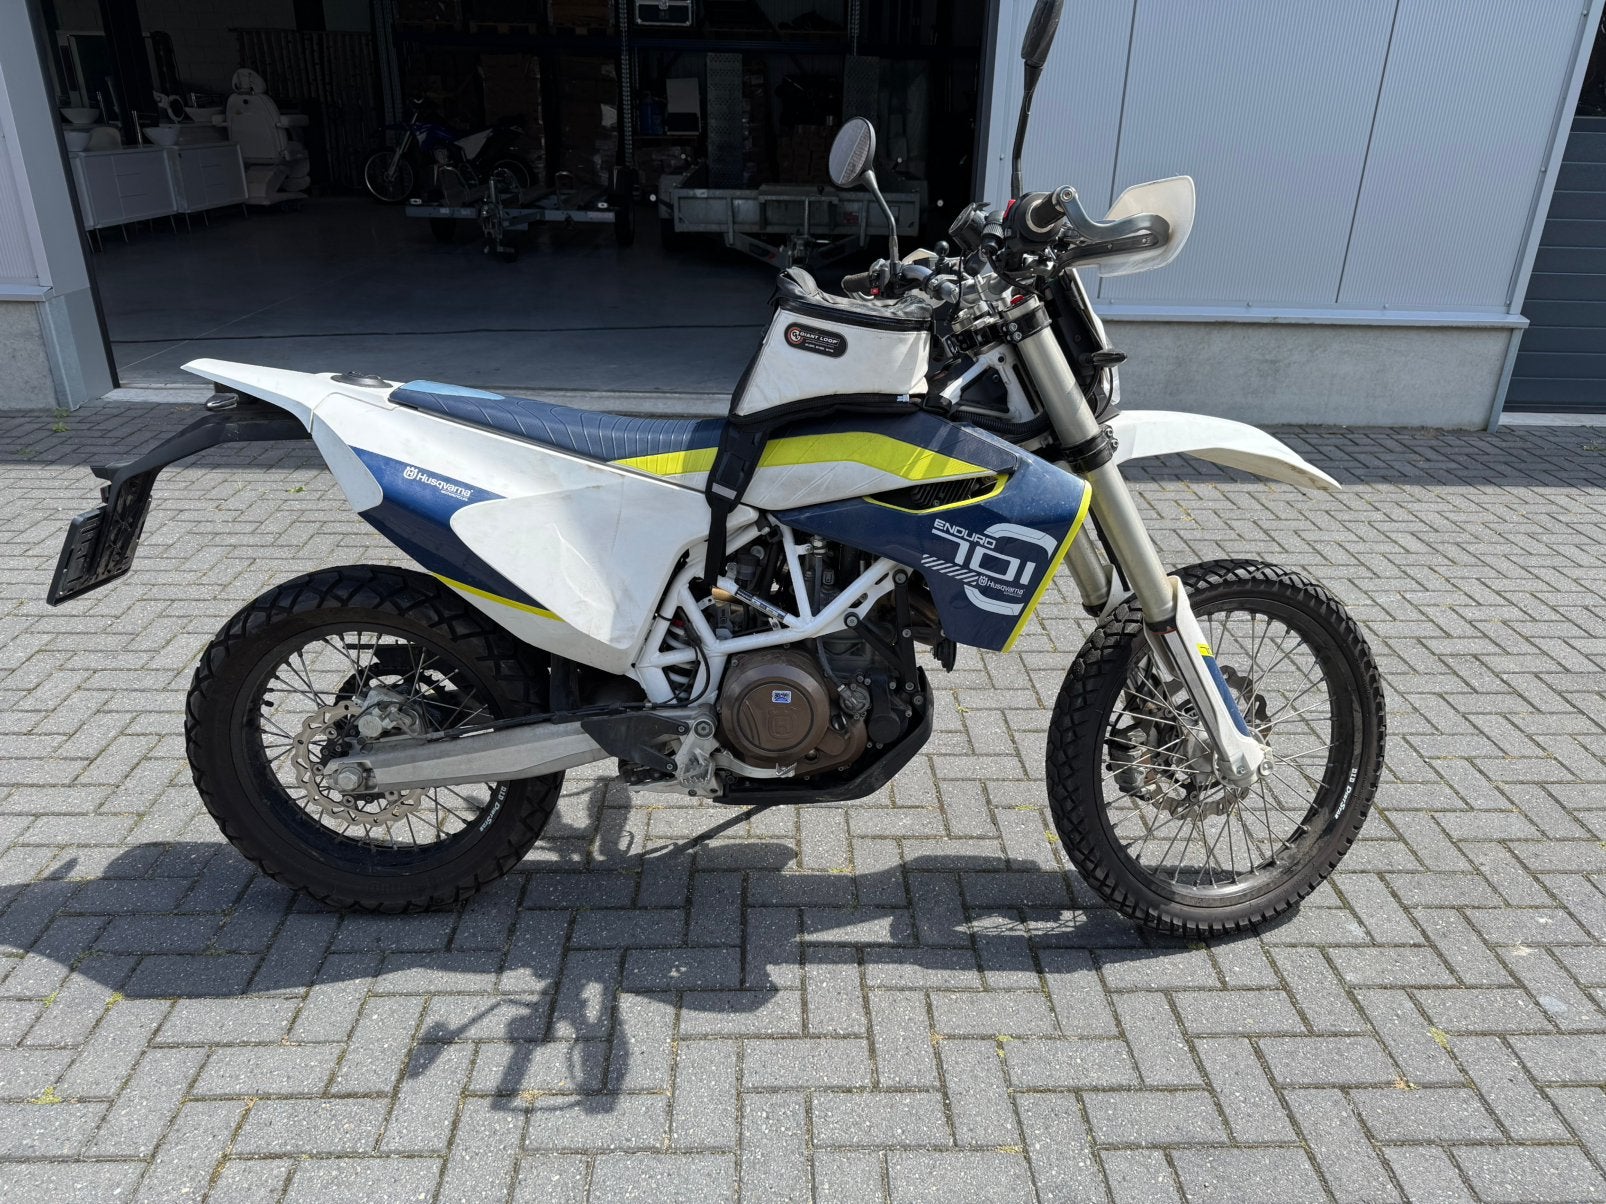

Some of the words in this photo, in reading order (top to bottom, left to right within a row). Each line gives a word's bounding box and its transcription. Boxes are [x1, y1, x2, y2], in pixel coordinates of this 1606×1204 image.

[416, 472, 471, 497] Husqvarna
[934, 519, 996, 549] ENDURO
[932, 529, 1036, 585] 701
[987, 580, 1023, 595] Husqvarna
